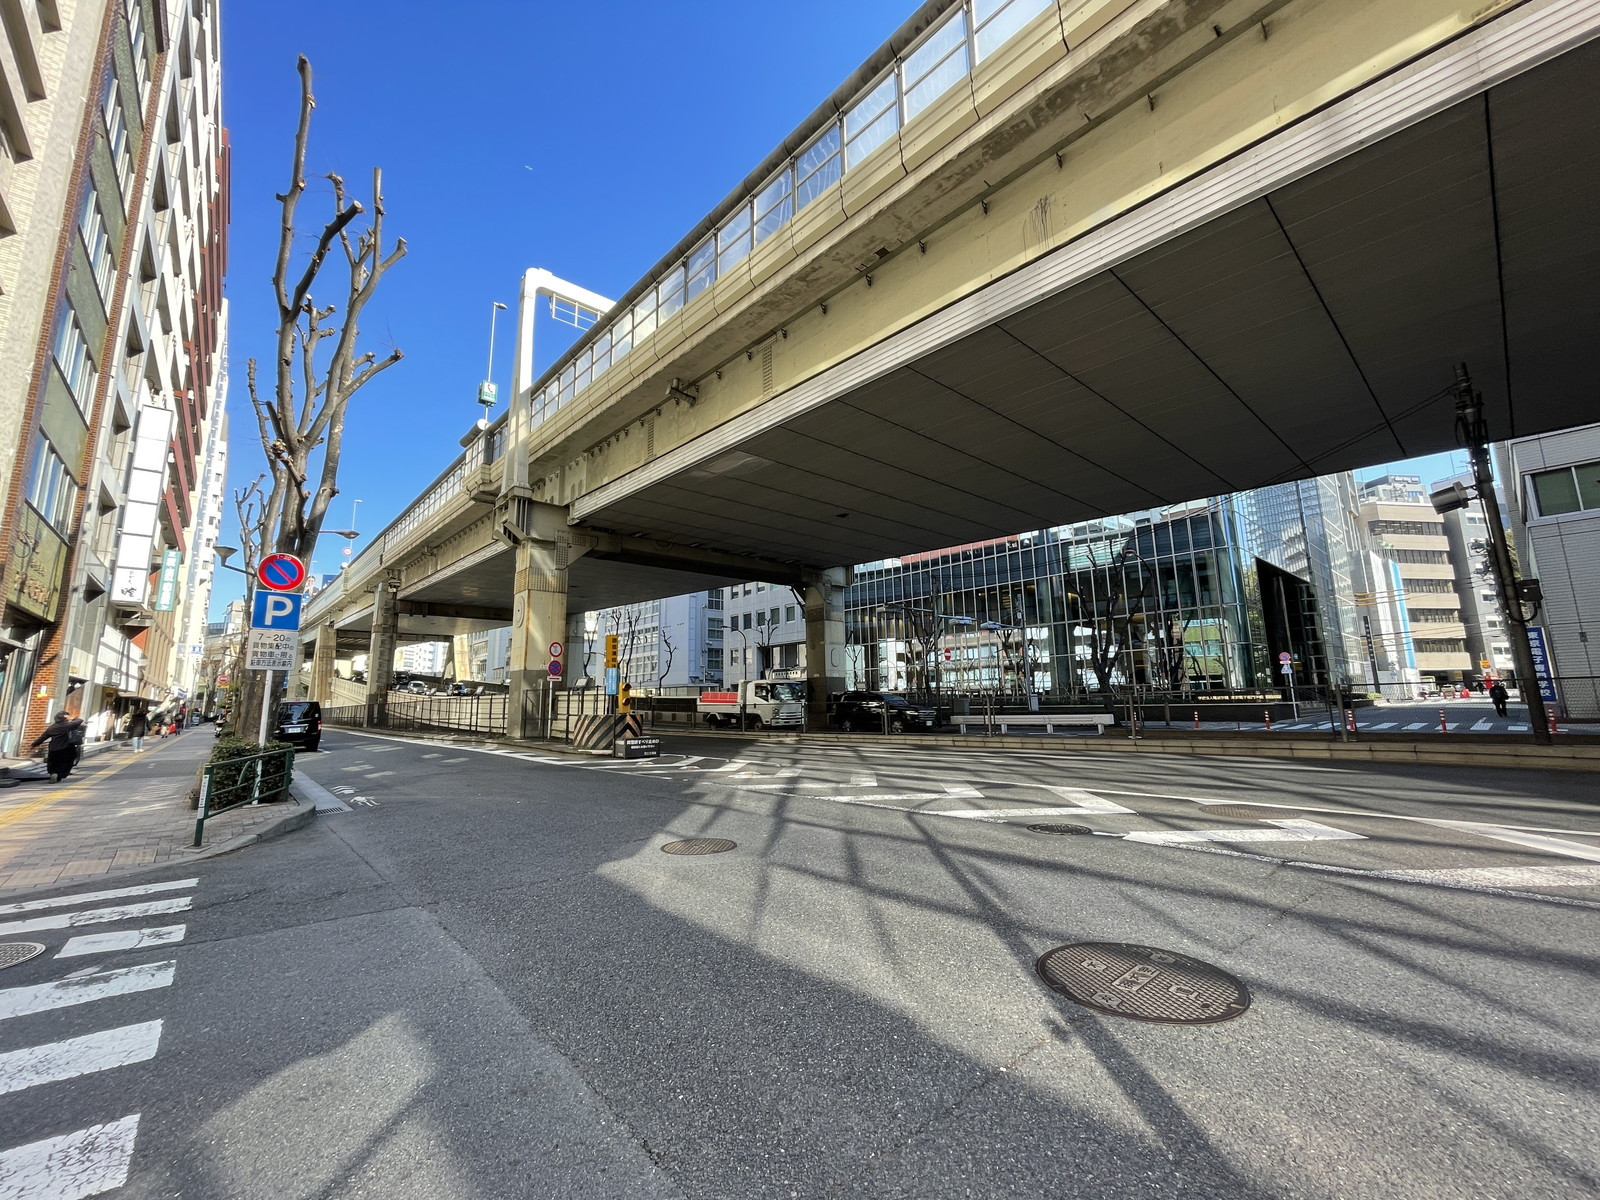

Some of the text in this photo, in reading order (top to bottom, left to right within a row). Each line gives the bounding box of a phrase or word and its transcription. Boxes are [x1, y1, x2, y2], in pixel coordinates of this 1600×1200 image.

[264, 595, 293, 625] P
[251, 650, 293, 659] 貨物車に限る
[252, 641, 294, 651] 貨物集配中の
[1527, 631, 1551, 697] 東京電子専門学校
